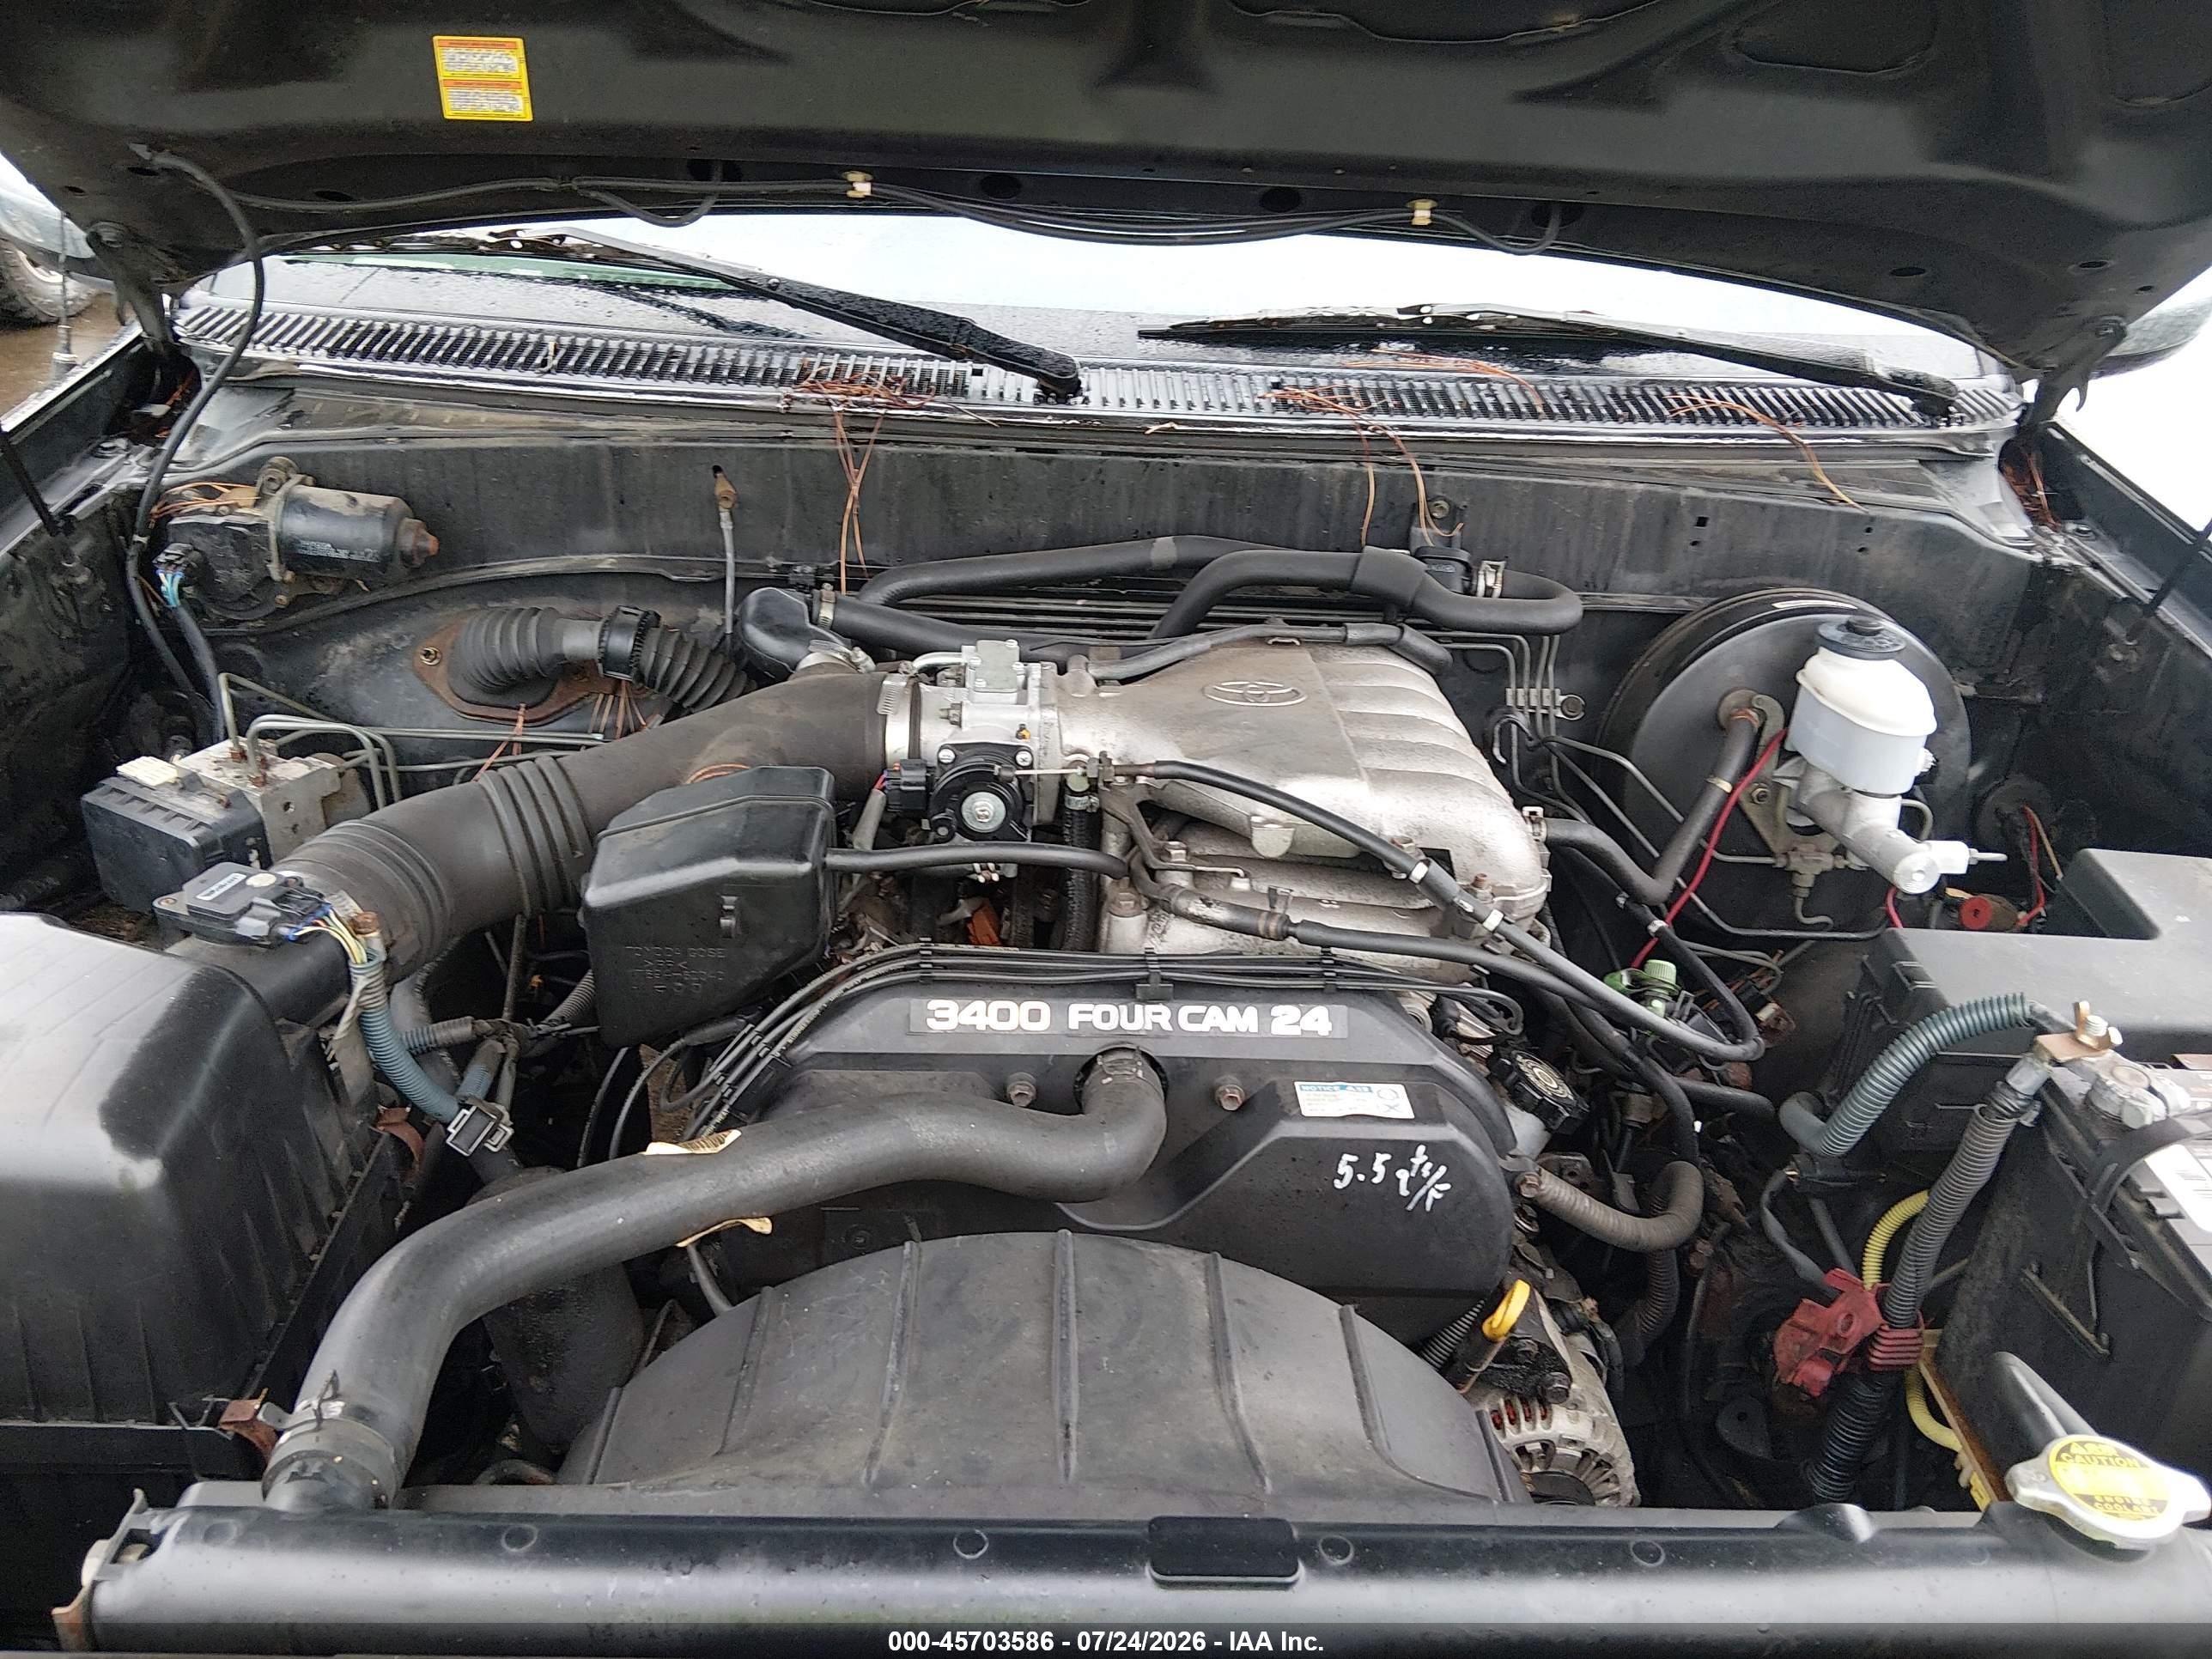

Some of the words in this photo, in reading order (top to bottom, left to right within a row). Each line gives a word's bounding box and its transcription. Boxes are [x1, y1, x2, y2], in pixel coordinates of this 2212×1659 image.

[926, 1000, 1051, 1031] 3400
[1067, 1002, 1174, 1031] FOUR
[1177, 1005, 1259, 1033] CAM
[1270, 1005, 1333, 1036] 24
[1333, 1152, 1393, 1189] 5.5
[2061, 1452, 2141, 1468] CAUTION
